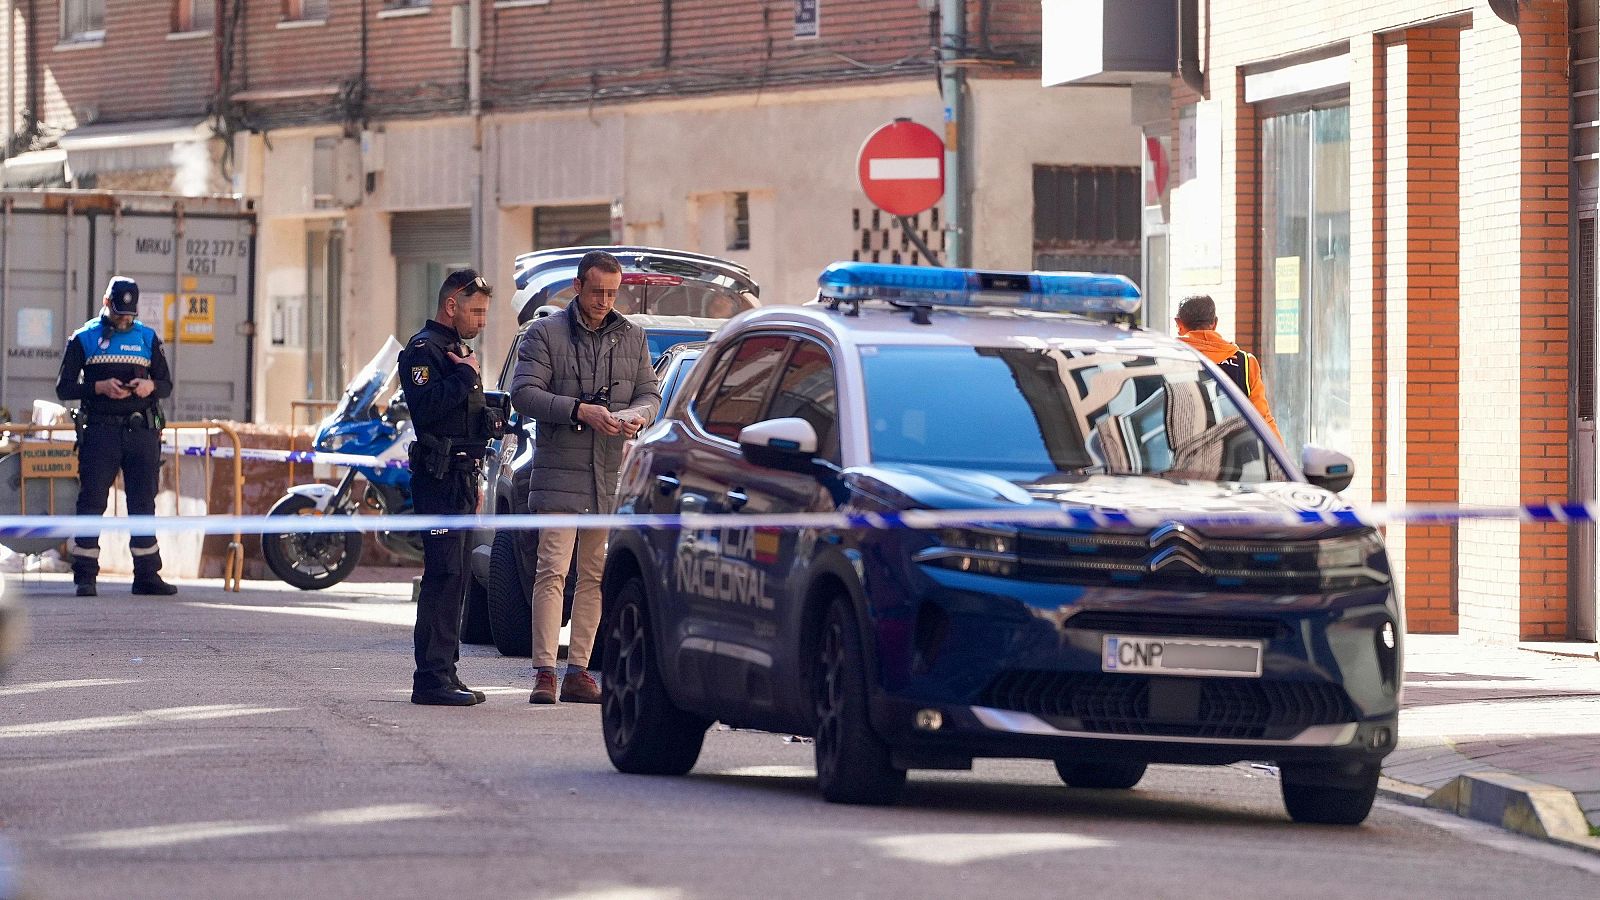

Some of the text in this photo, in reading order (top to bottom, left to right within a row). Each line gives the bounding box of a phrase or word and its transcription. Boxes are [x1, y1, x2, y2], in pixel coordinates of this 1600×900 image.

[135, 238, 172, 255] MRKU
[430, 528, 449, 536] CNP
[676, 554, 775, 611] NACIONAL
[1119, 642, 1163, 666] CNP
